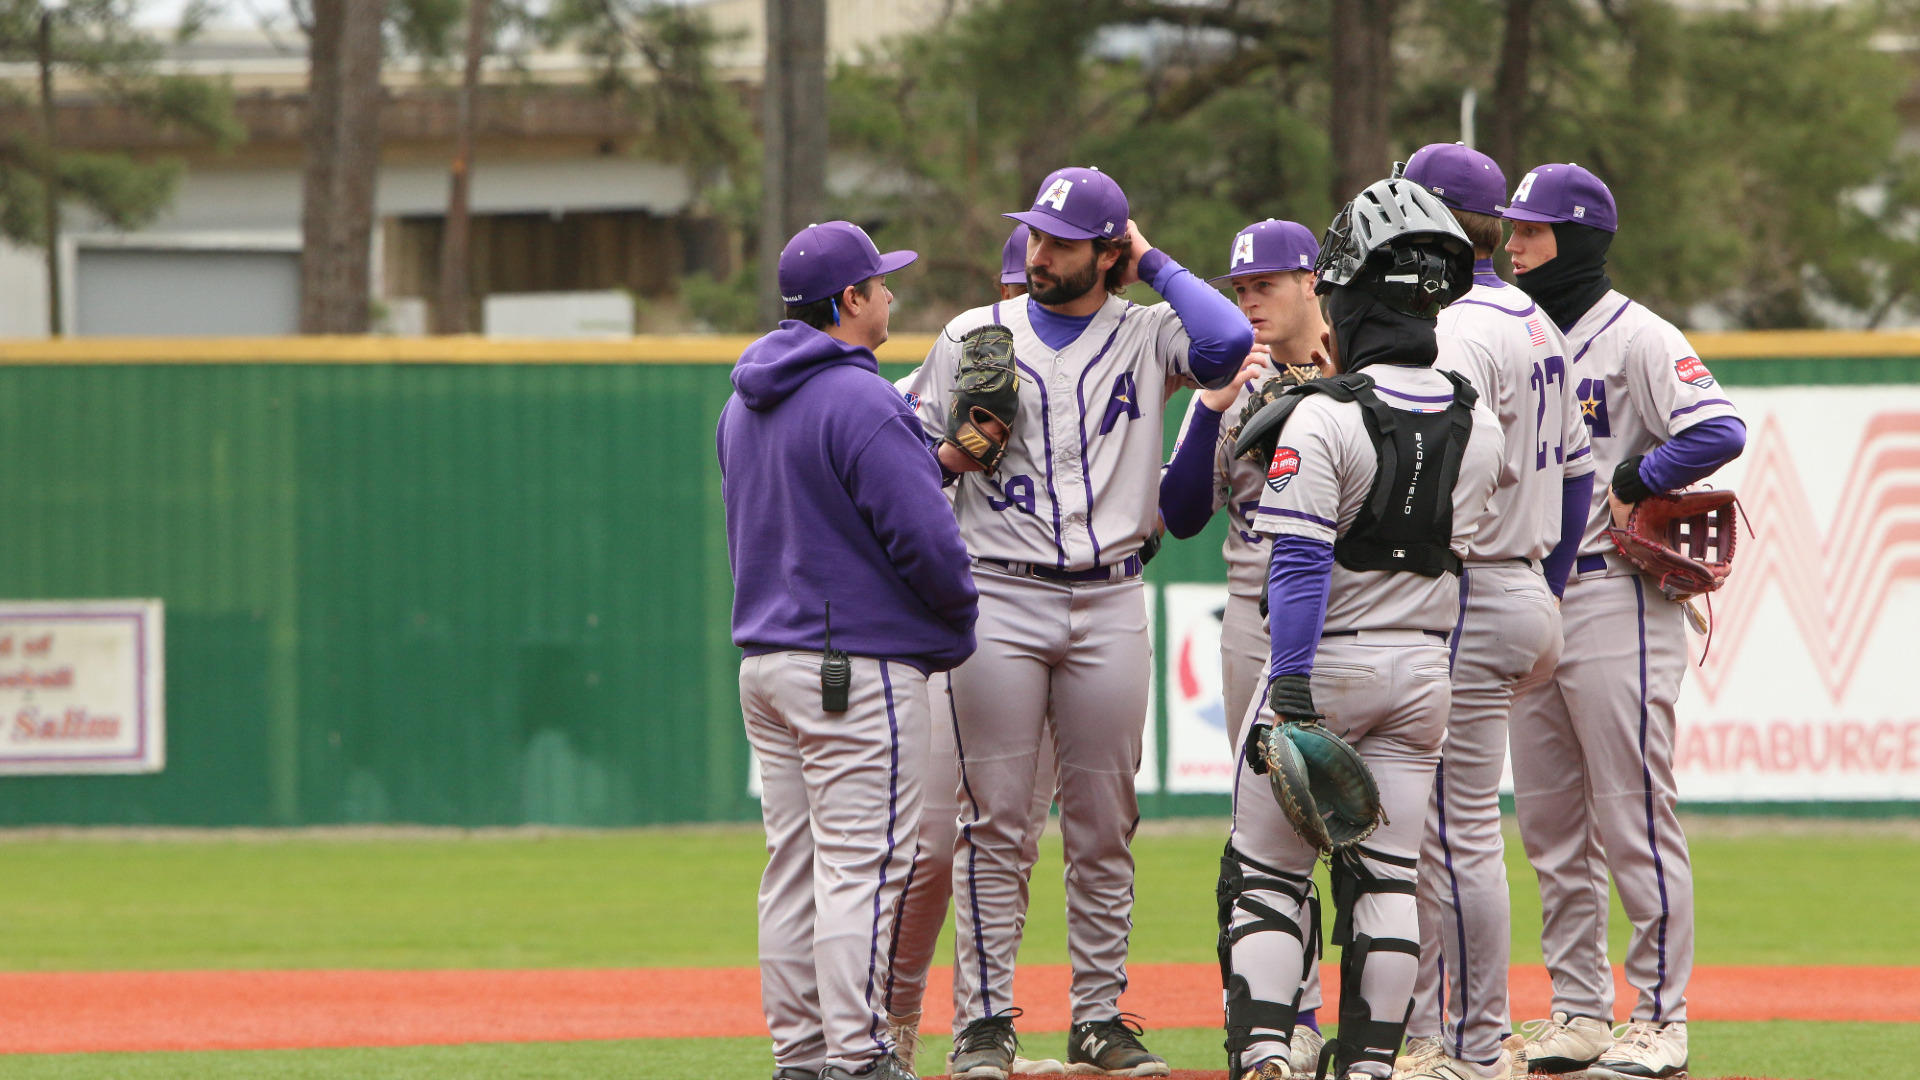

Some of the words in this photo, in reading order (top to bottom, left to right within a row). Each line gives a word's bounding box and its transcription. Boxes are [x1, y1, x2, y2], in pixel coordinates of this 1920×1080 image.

[1036, 178, 1074, 211] A
[1511, 173, 1538, 202] A
[1231, 233, 1254, 269] A
[1099, 371, 1141, 436] A
[1531, 355, 1565, 471] 27
[1404, 432, 1423, 515] EVOSHIELD
